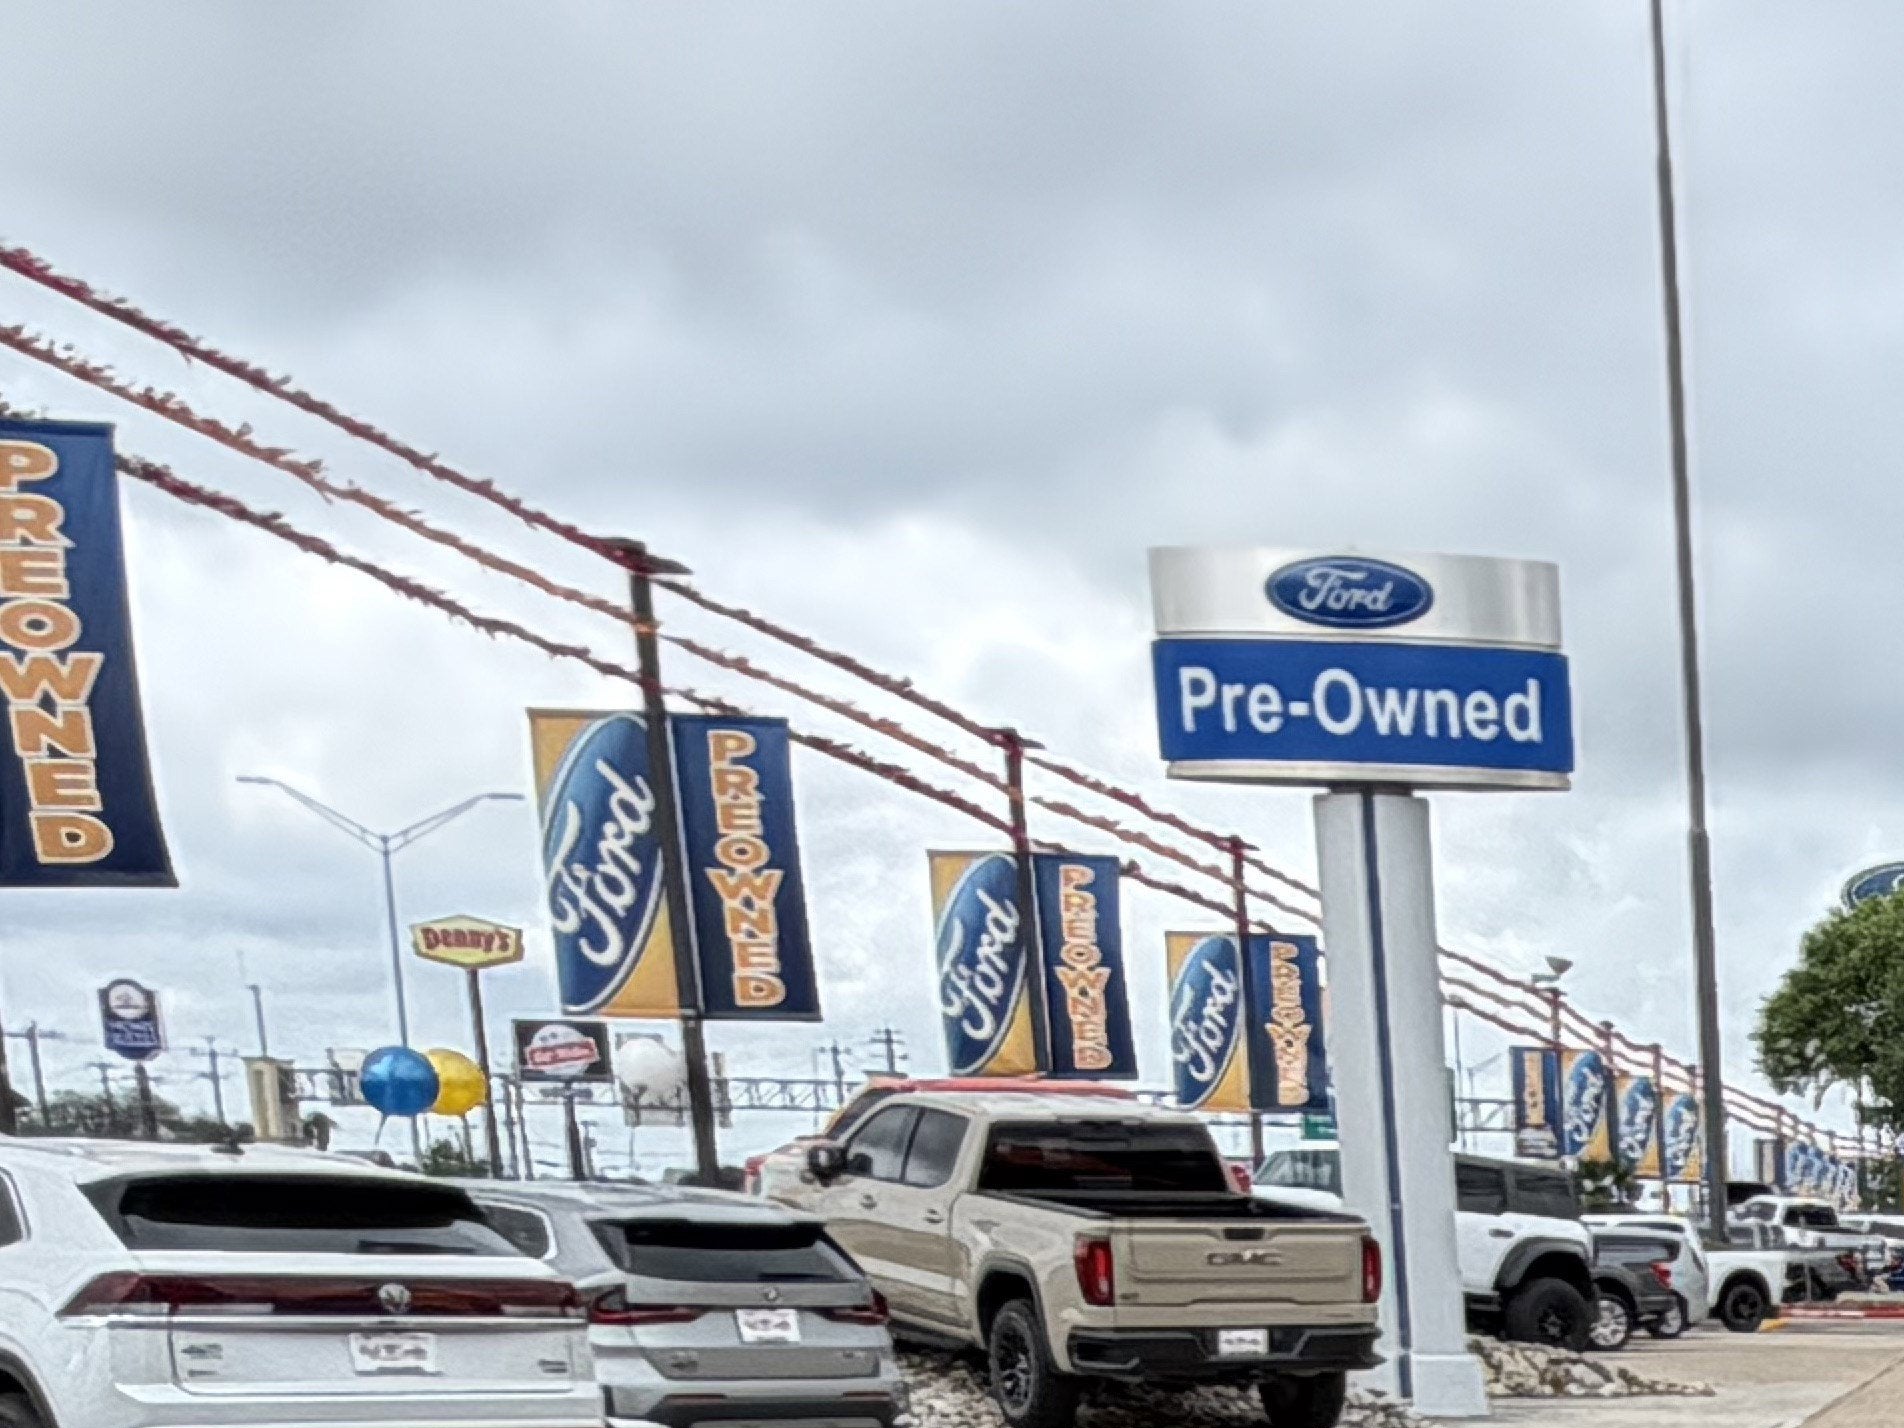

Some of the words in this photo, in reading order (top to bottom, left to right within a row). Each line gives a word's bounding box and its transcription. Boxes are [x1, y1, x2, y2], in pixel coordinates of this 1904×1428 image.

[0, 439, 114, 864] PREOWNED
[1299, 566, 1393, 612] Ford
[1178, 666, 1543, 744] Pre-Owned
[550, 758, 656, 966] Ford
[704, 730, 786, 1008] PREOWNED
[420, 927, 511, 951] Denny's
[941, 887, 1021, 1041] Ford
[1172, 960, 1239, 1082] Ford
